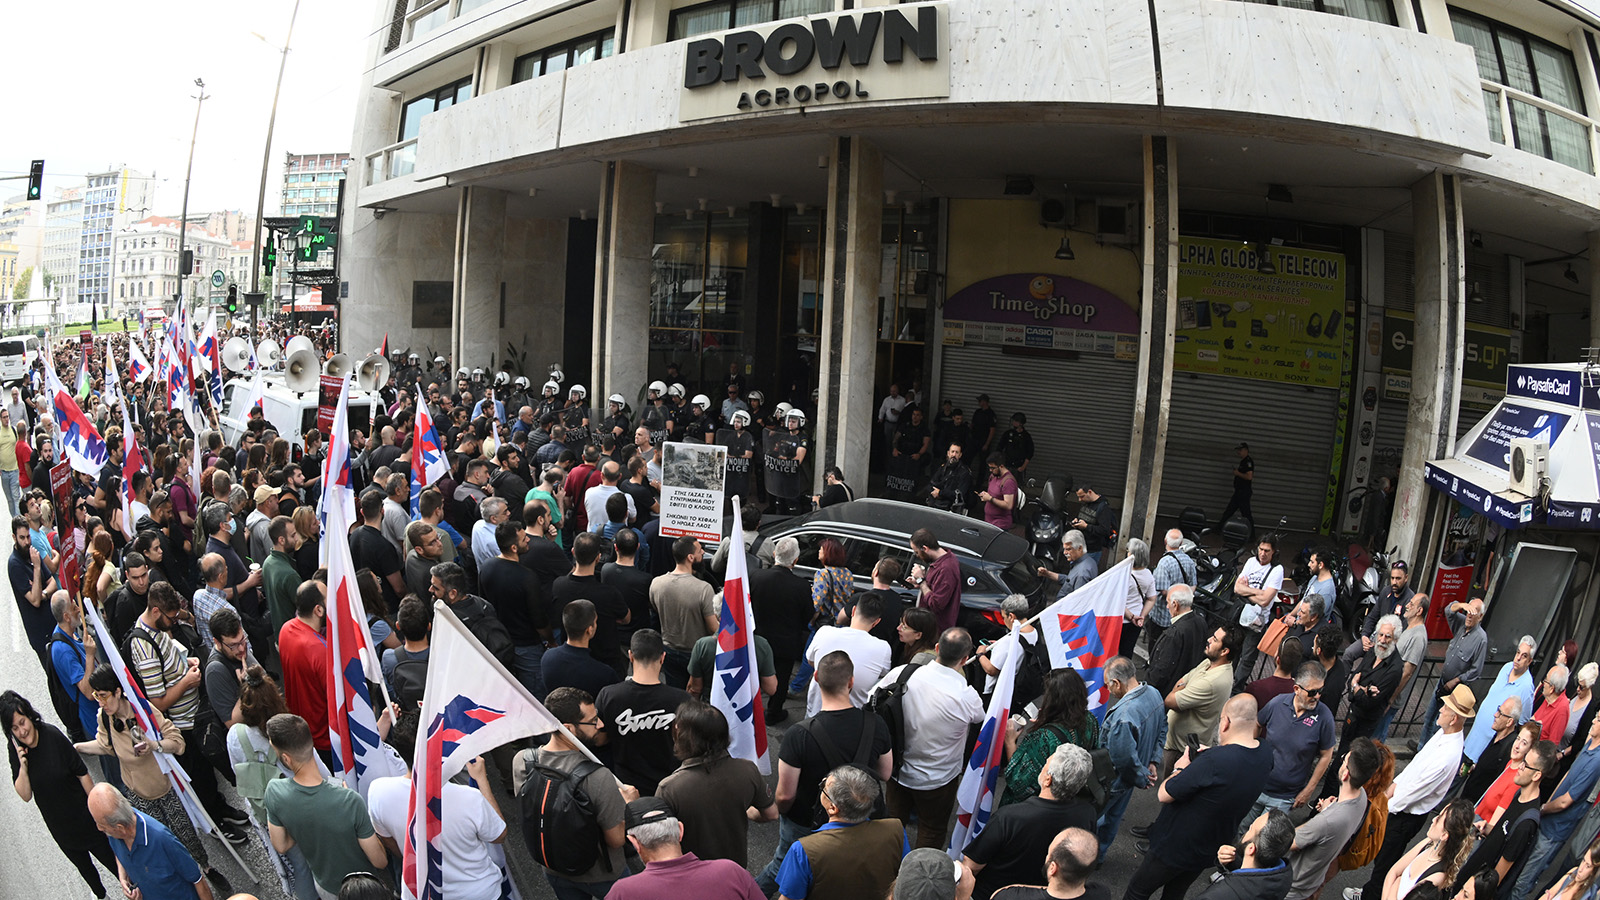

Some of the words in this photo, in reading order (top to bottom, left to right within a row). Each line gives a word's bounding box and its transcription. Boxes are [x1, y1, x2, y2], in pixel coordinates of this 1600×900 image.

[685, 6, 938, 89] BROWN
[737, 79, 869, 110] ACROPOL
[1180, 244, 1215, 266] LPHA
[1221, 248, 1262, 272] GLOB
[1278, 254, 1338, 281] TELECOM
[1267, 285, 1301, 295] SERVICES
[988, 290, 1034, 312] Time
[1033, 306, 1051, 321] to
[1048, 295, 1096, 323] Shop
[1026, 327, 1053, 336] CASIO
[1195, 338, 1219, 346] NOKIA
[1317, 350, 1337, 360] DELL
[1273, 359, 1295, 368] ASUS
[1243, 370, 1279, 379] ALCATEL
[1284, 373, 1310, 382] SONY
[1387, 378, 1410, 388] CASI
[1526, 374, 1571, 396] PaysafeCard
[728, 457, 750, 466] ΝΟΜΙΑ
[765, 460, 797, 474] POLICE
[727, 465, 748, 473] LICE
[670, 496, 702, 504] ΣΥΝΤΡΙΜΜΙΑ
[666, 513, 689, 521] ΣΗΚΩΝΕΙ
[698, 516, 718, 524] ΚΕΦΑΛΙ
[677, 520, 695, 528] ΗΡΩΑΣ
